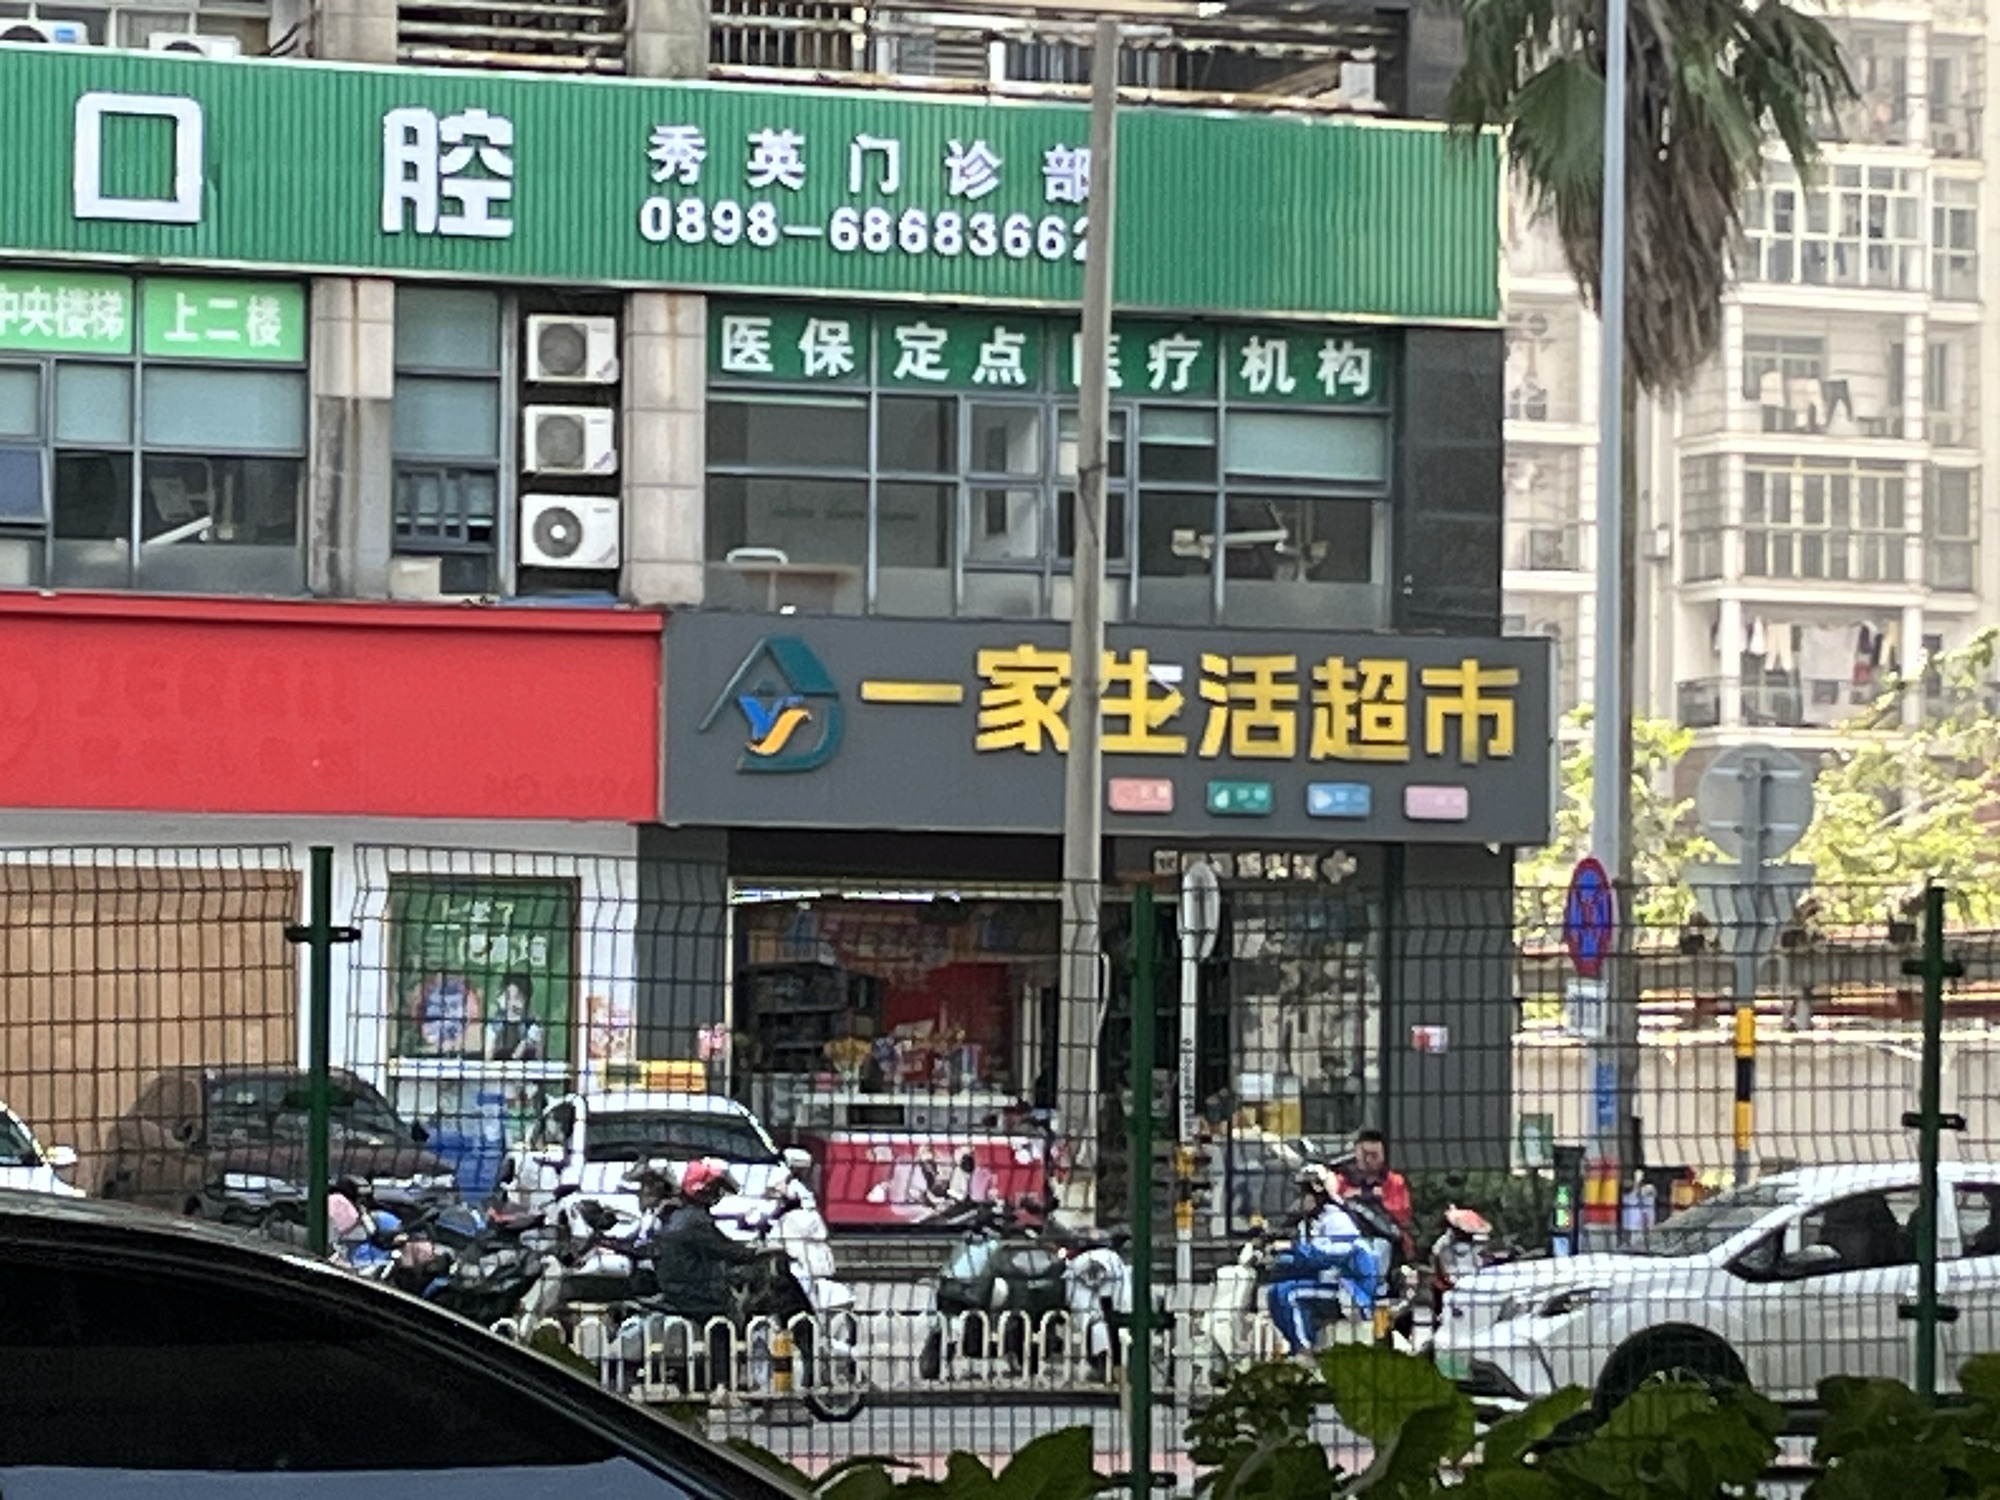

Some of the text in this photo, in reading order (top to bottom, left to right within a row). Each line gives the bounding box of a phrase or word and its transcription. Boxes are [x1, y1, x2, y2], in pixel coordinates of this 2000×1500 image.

[74, 92, 514, 238] 口腔
[648, 124, 1091, 203] 秀英门诊部
[163, 291, 283, 347] 上二楼
[861, 644, 1520, 764] 一家生活超市
